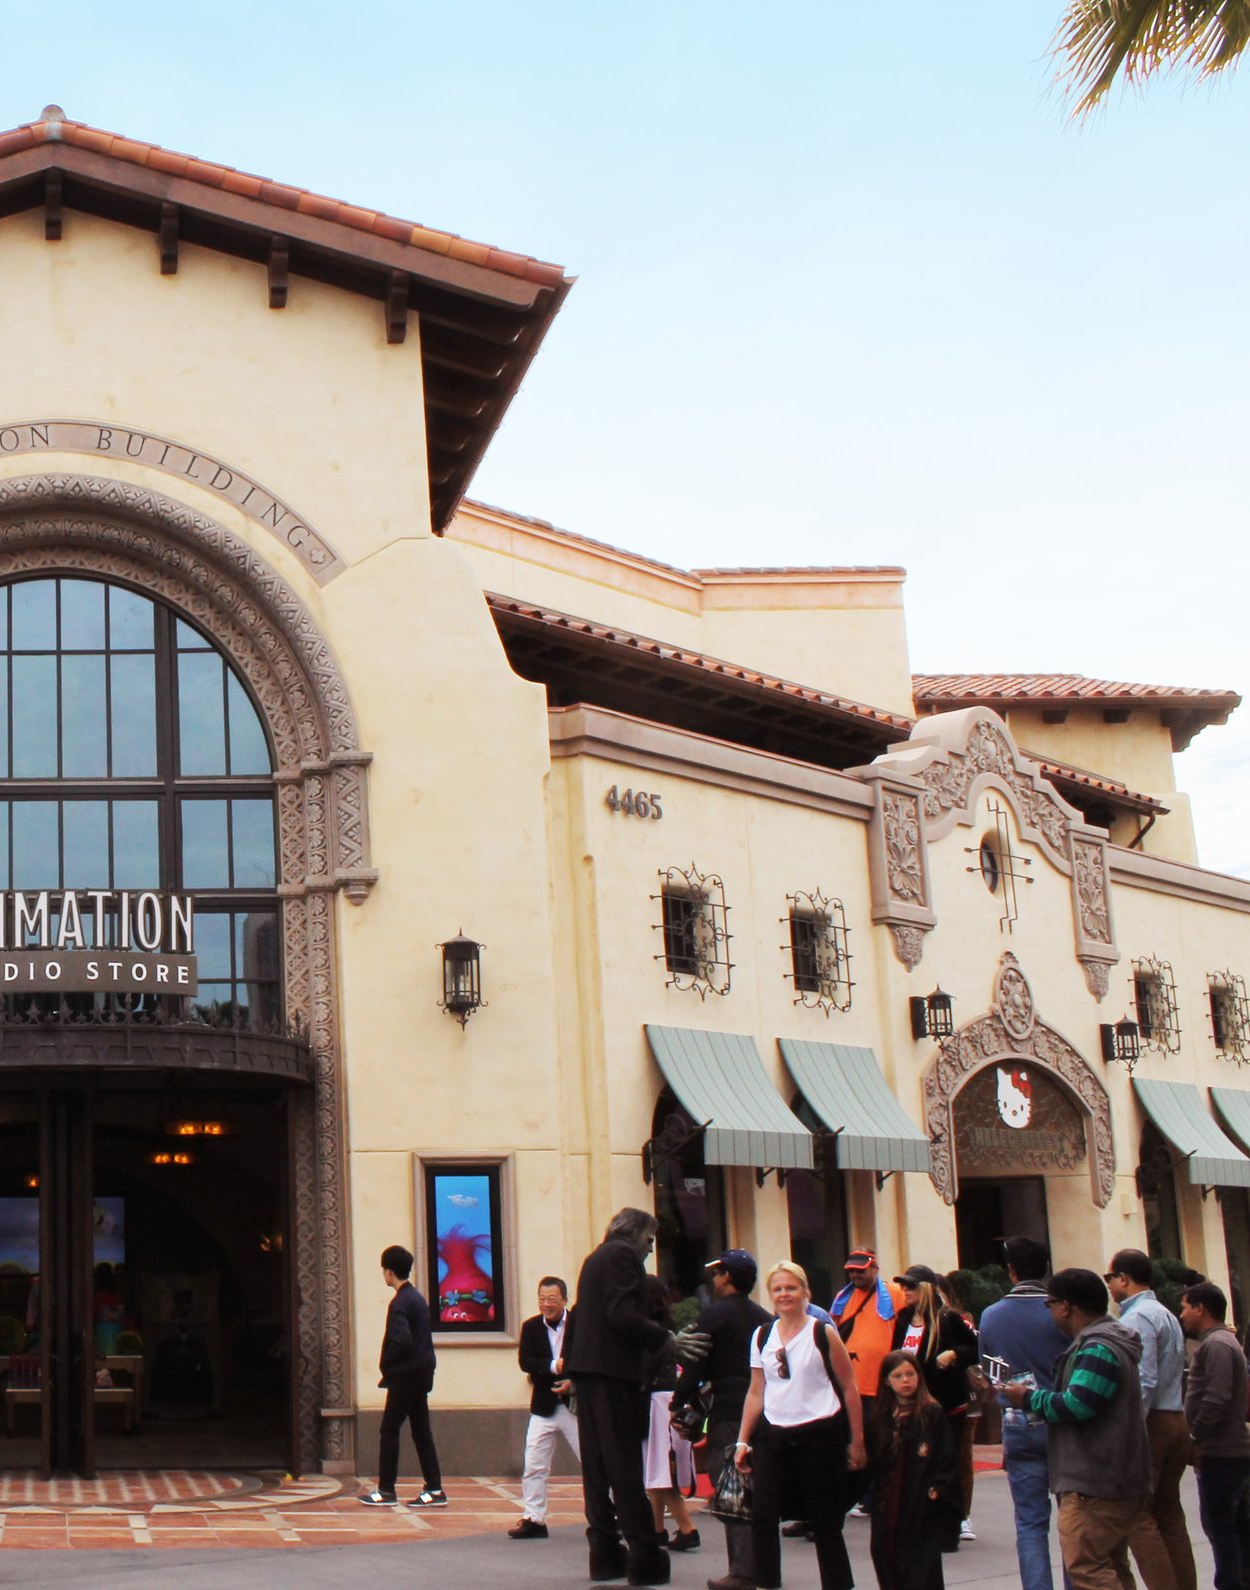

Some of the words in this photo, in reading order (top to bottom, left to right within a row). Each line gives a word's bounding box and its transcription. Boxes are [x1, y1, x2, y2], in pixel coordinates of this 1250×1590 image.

[95, 428, 311, 549] BUILDING
[605, 784, 663, 820] 4465
[86, 961, 190, 985] STORE
